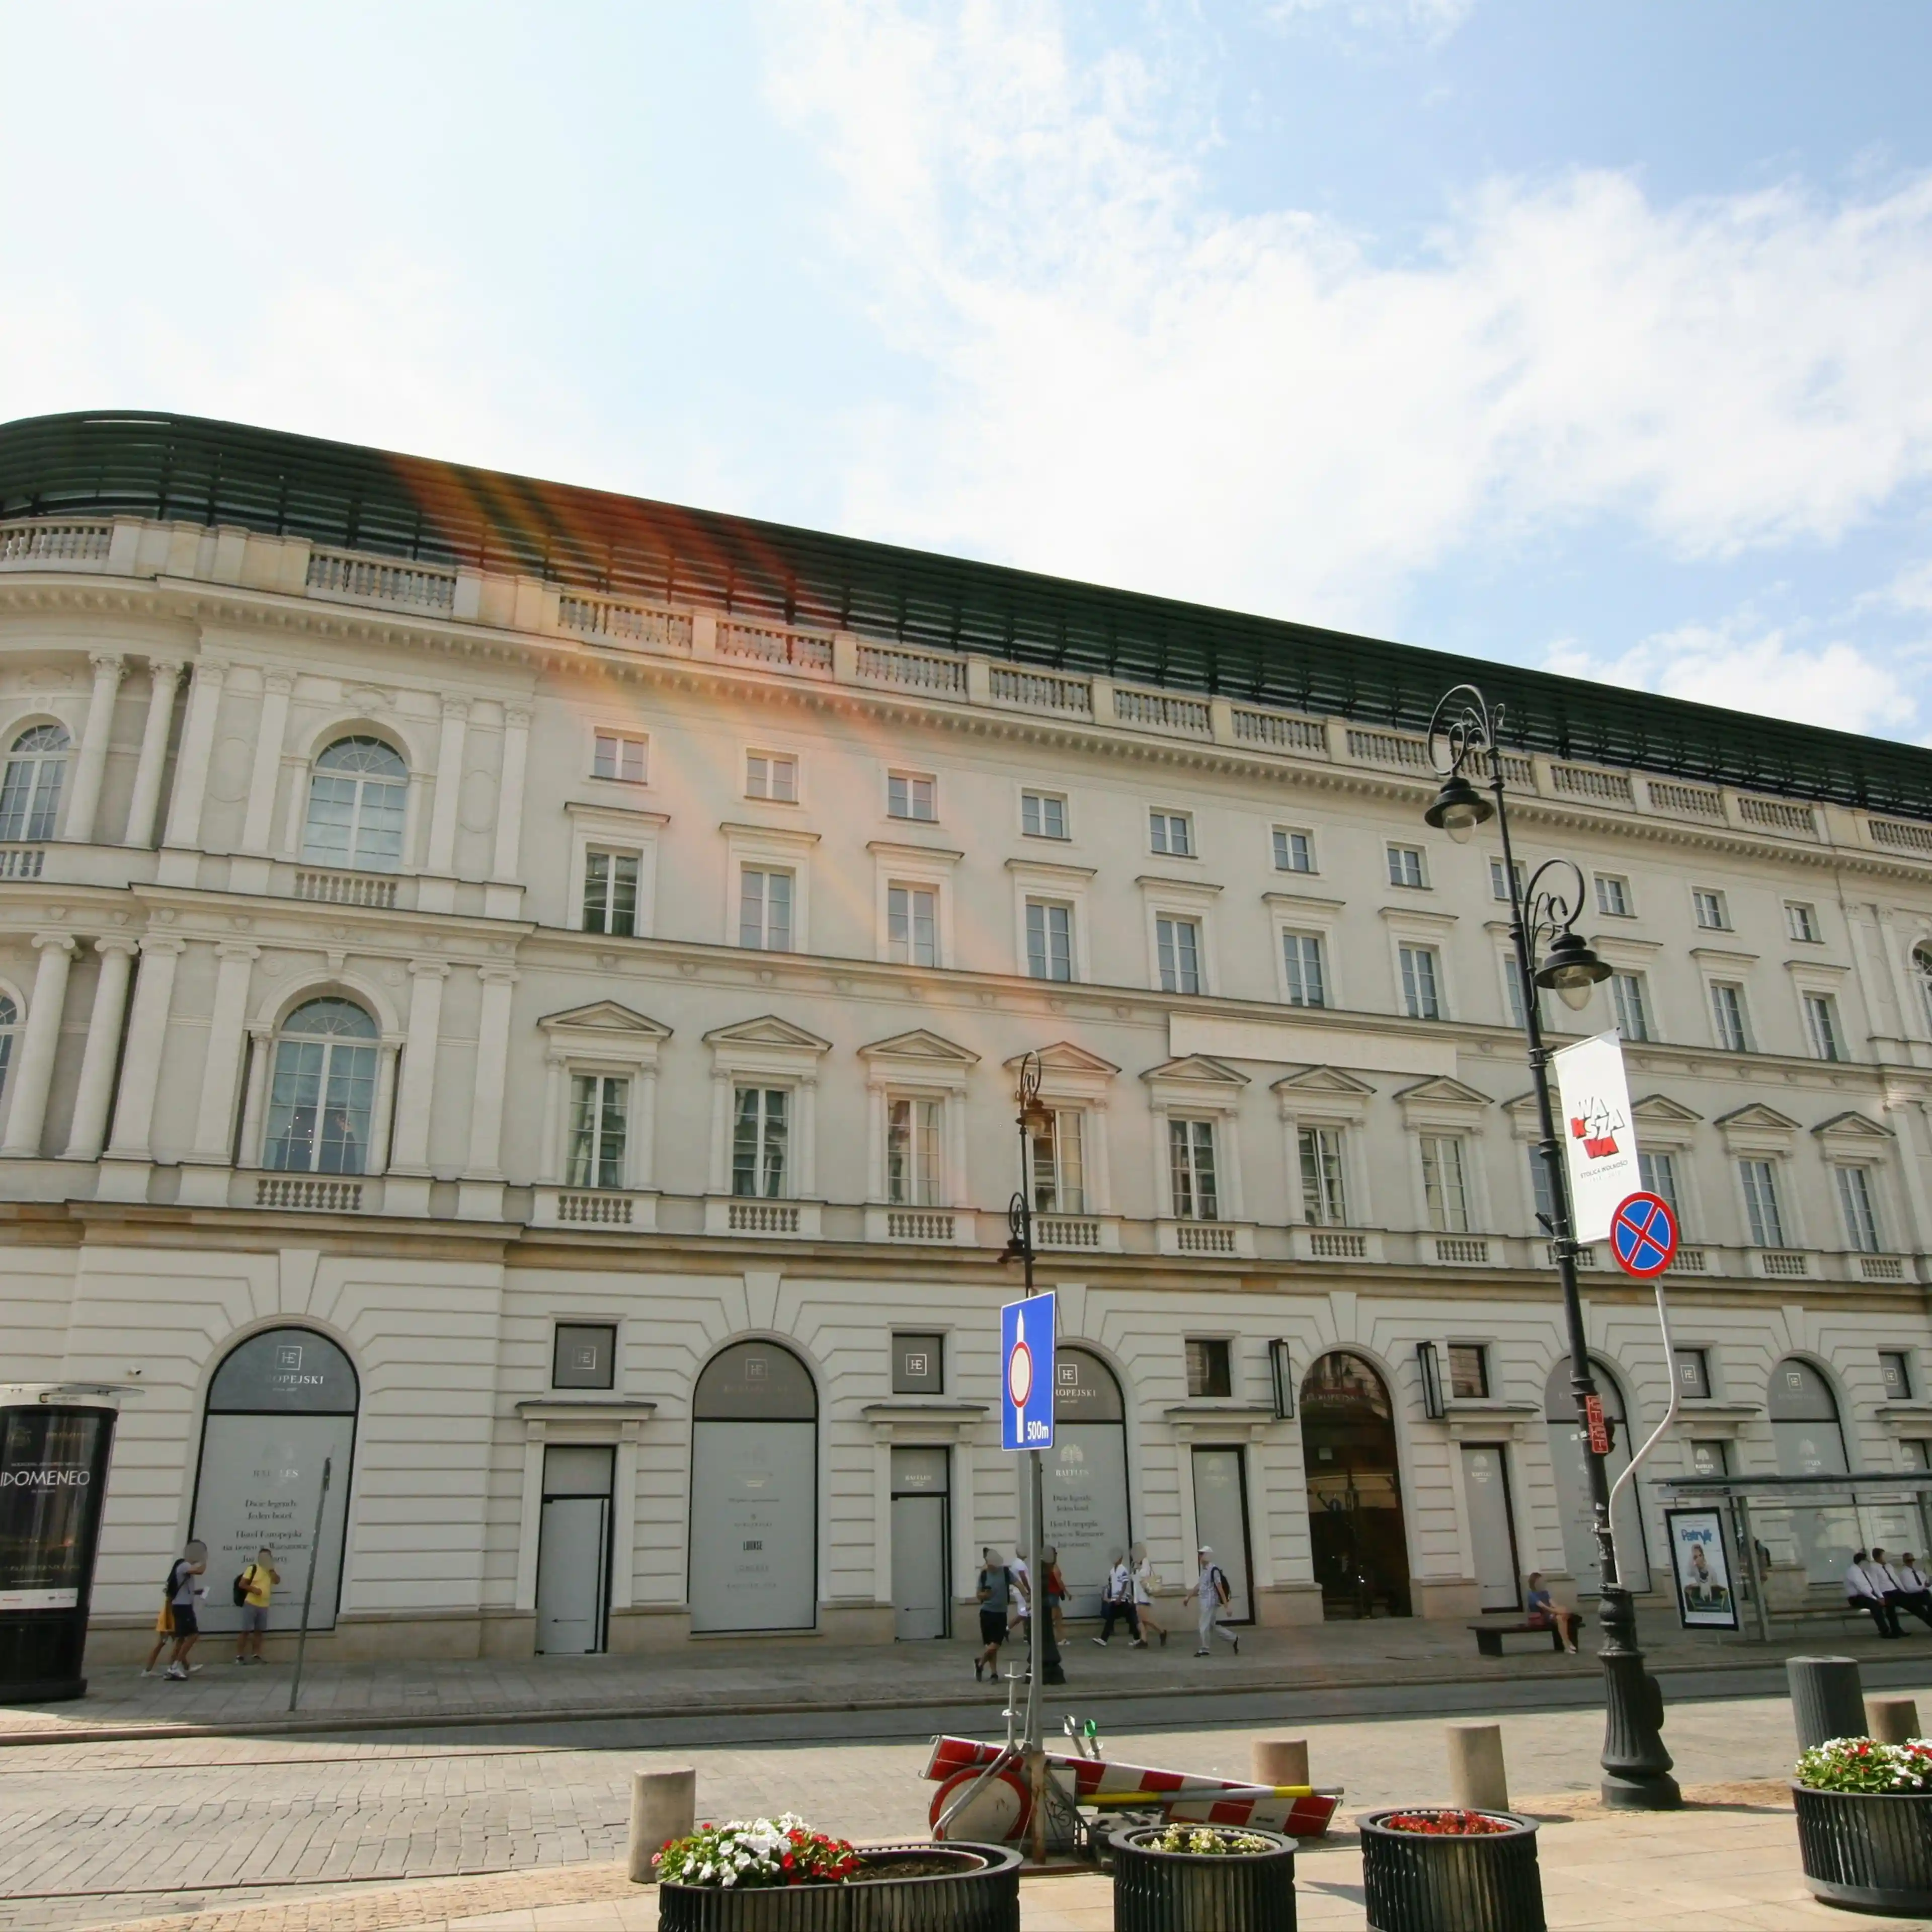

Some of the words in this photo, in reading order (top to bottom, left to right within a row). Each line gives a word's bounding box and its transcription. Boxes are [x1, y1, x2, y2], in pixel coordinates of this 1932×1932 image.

[266, 1375, 324, 1384] ROPEJSKI
[1055, 1388, 1096, 1397] ROPEJSKI
[1027, 1420, 1049, 1440] 500m
[0, 1471, 90, 1487] IDOMENEO
